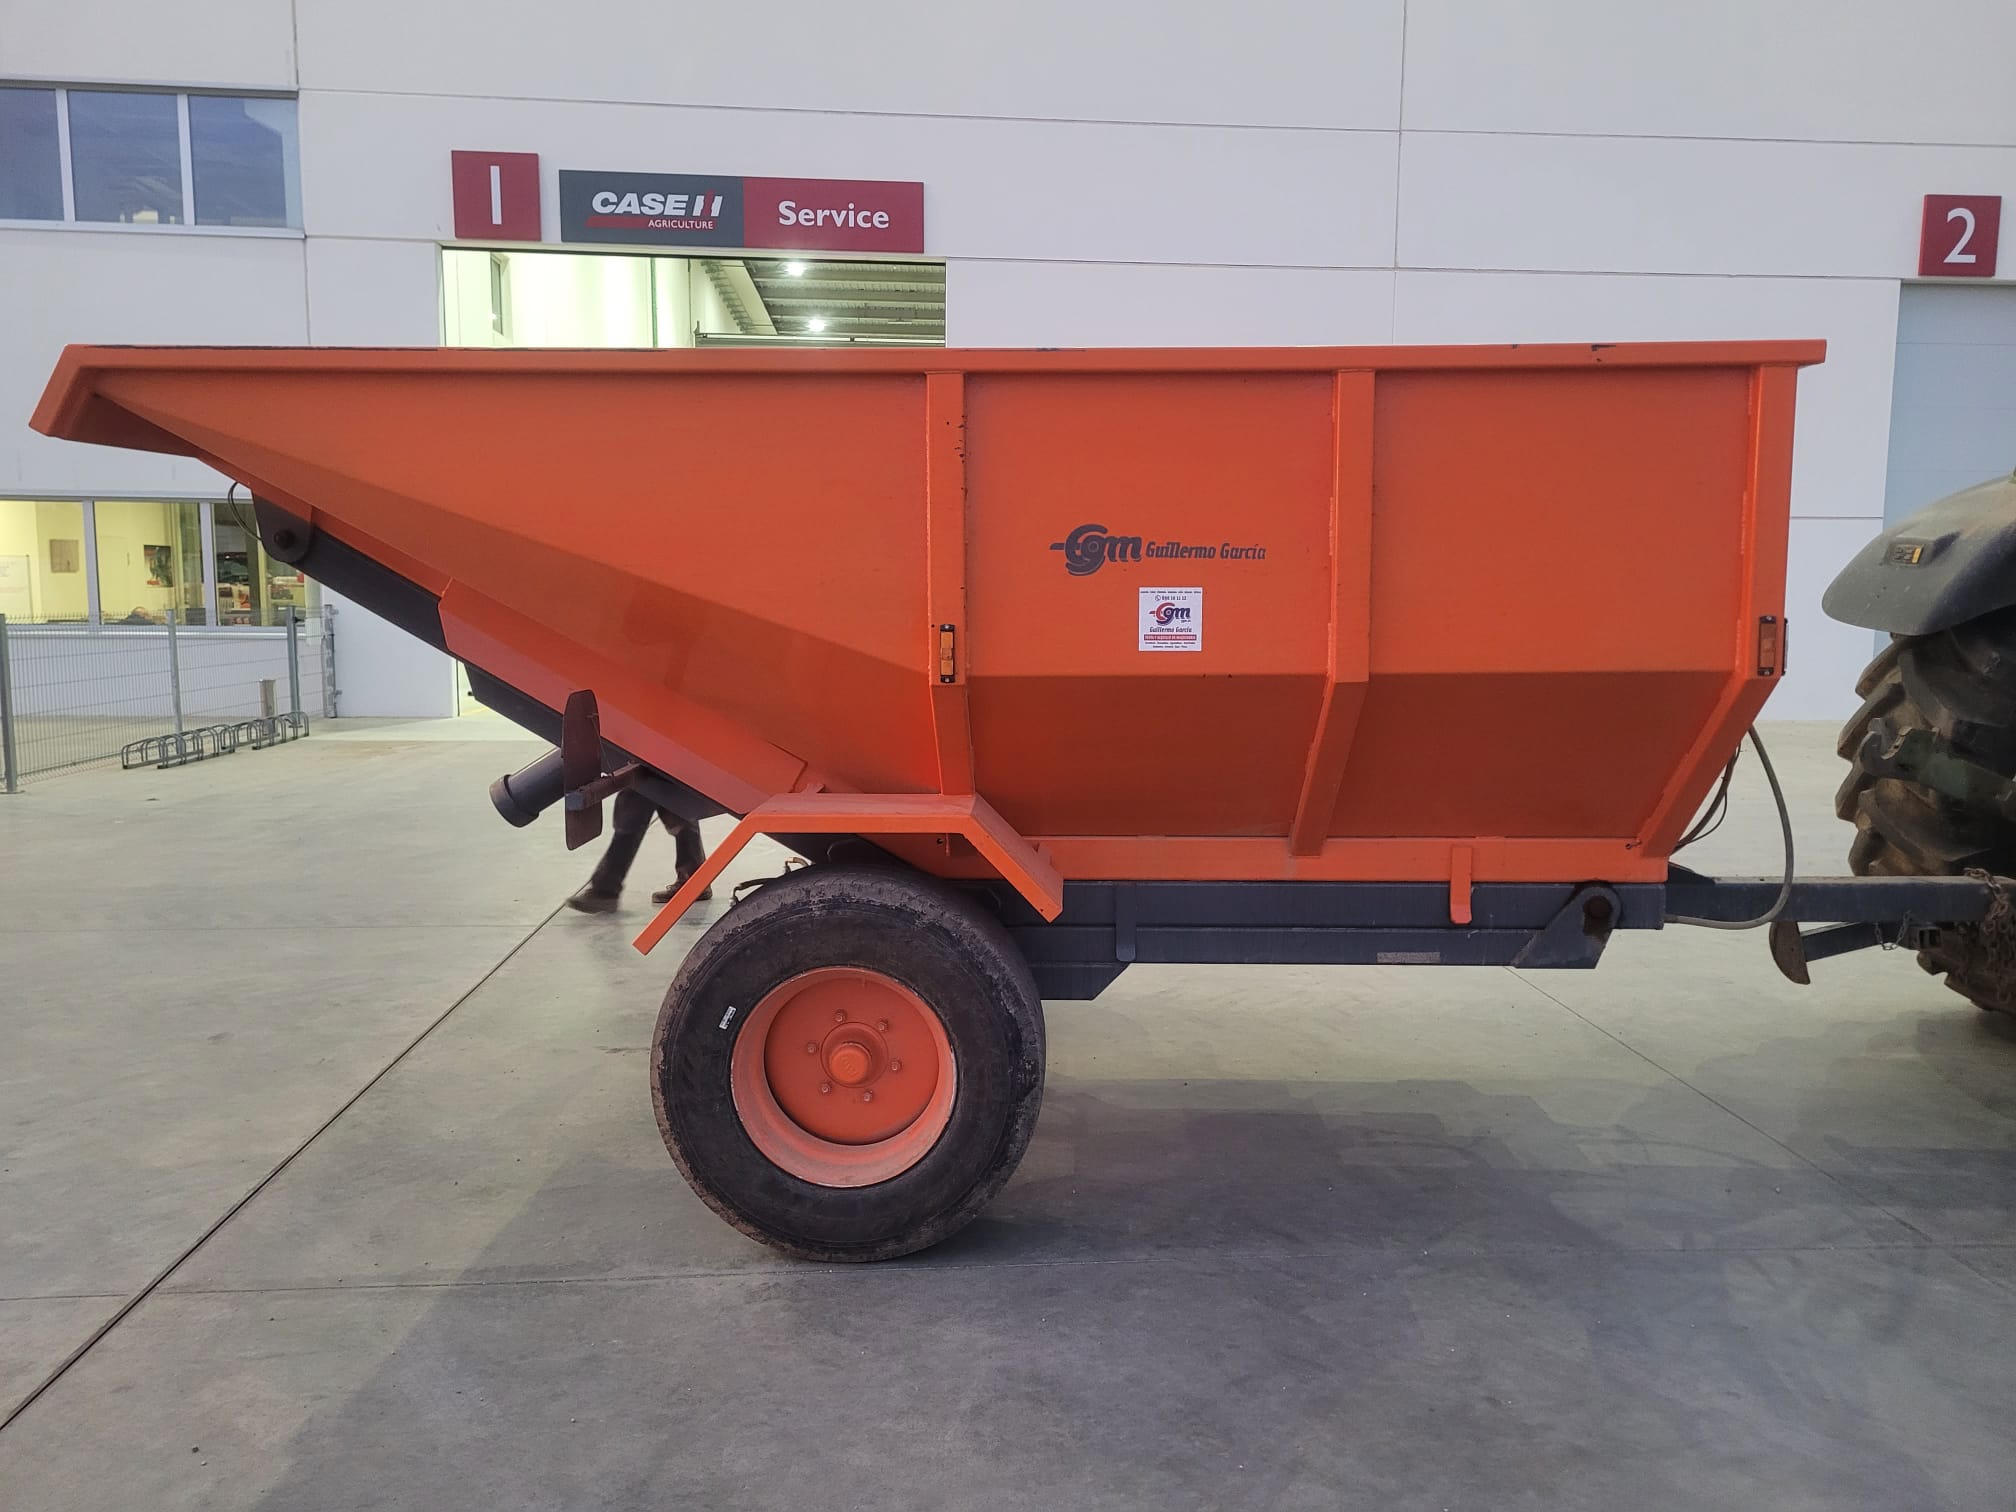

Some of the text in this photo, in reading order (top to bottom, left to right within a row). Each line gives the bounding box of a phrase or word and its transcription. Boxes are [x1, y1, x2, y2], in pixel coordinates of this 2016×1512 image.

[592, 191, 689, 216] CASE
[778, 200, 890, 229] Service
[648, 219, 714, 230] AGRICULTURE
[1943, 207, 1977, 264] 2
[1145, 541, 1217, 560] Guillermo
